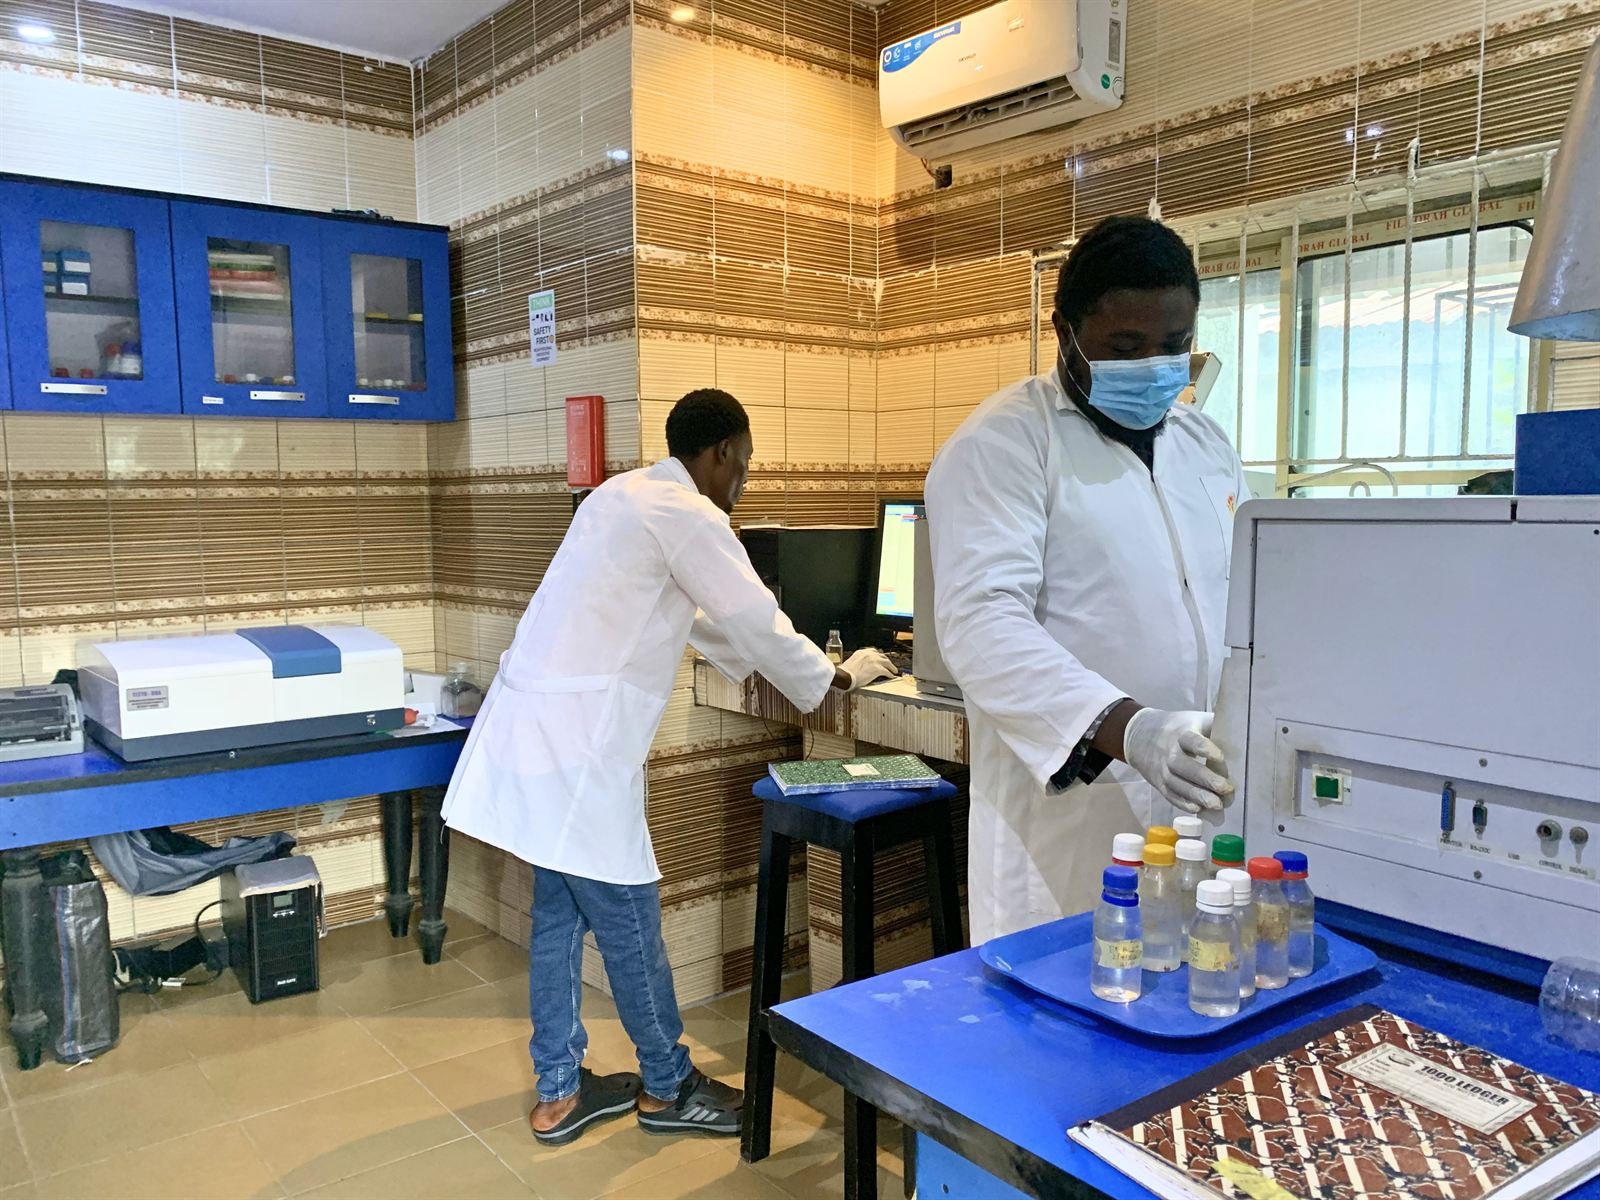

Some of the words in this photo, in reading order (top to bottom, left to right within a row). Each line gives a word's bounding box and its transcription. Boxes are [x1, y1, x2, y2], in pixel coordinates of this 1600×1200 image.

[1452, 199, 1505, 218] GLBAL
[1226, 256, 1263, 270] GLBAL
[533, 325, 552, 336] SAFETY
[536, 335, 549, 345] FIRST
[1421, 1065, 1457, 1082] 1000
[1457, 1080, 1509, 1104] LEDGER
